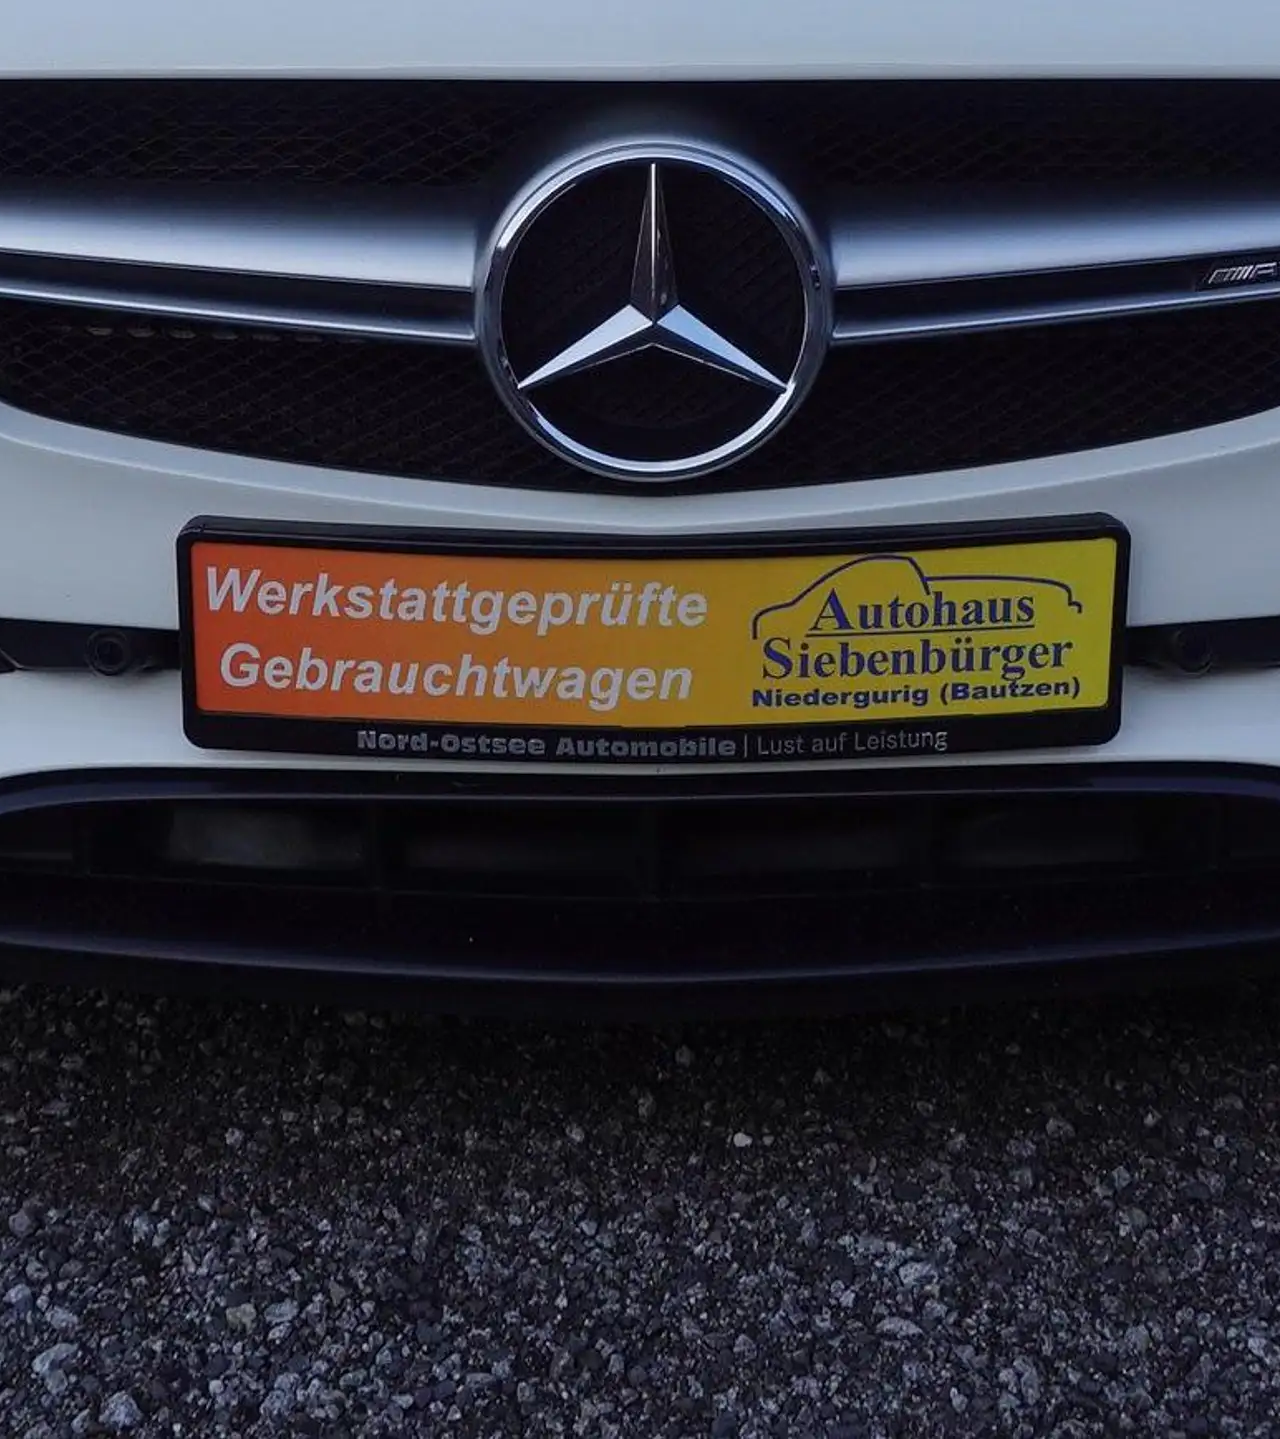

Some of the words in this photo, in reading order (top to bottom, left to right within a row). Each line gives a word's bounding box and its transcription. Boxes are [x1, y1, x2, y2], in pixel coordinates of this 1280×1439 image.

[206, 566, 708, 636] Werkstattgeprüfte
[809, 587, 1035, 632] Autohaus
[220, 642, 693, 711] Gebrauchtwagen
[761, 637, 1074, 681] Siebenbürger
[752, 685, 929, 708] Niedergurig
[939, 677, 1081, 705] (Bautzen)
[356, 729, 546, 756] Nord-Ostsee
[555, 736, 737, 758] Automobile
[757, 733, 805, 756] Lust
[810, 732, 848, 753] auf
[854, 728, 949, 752] Leistung
